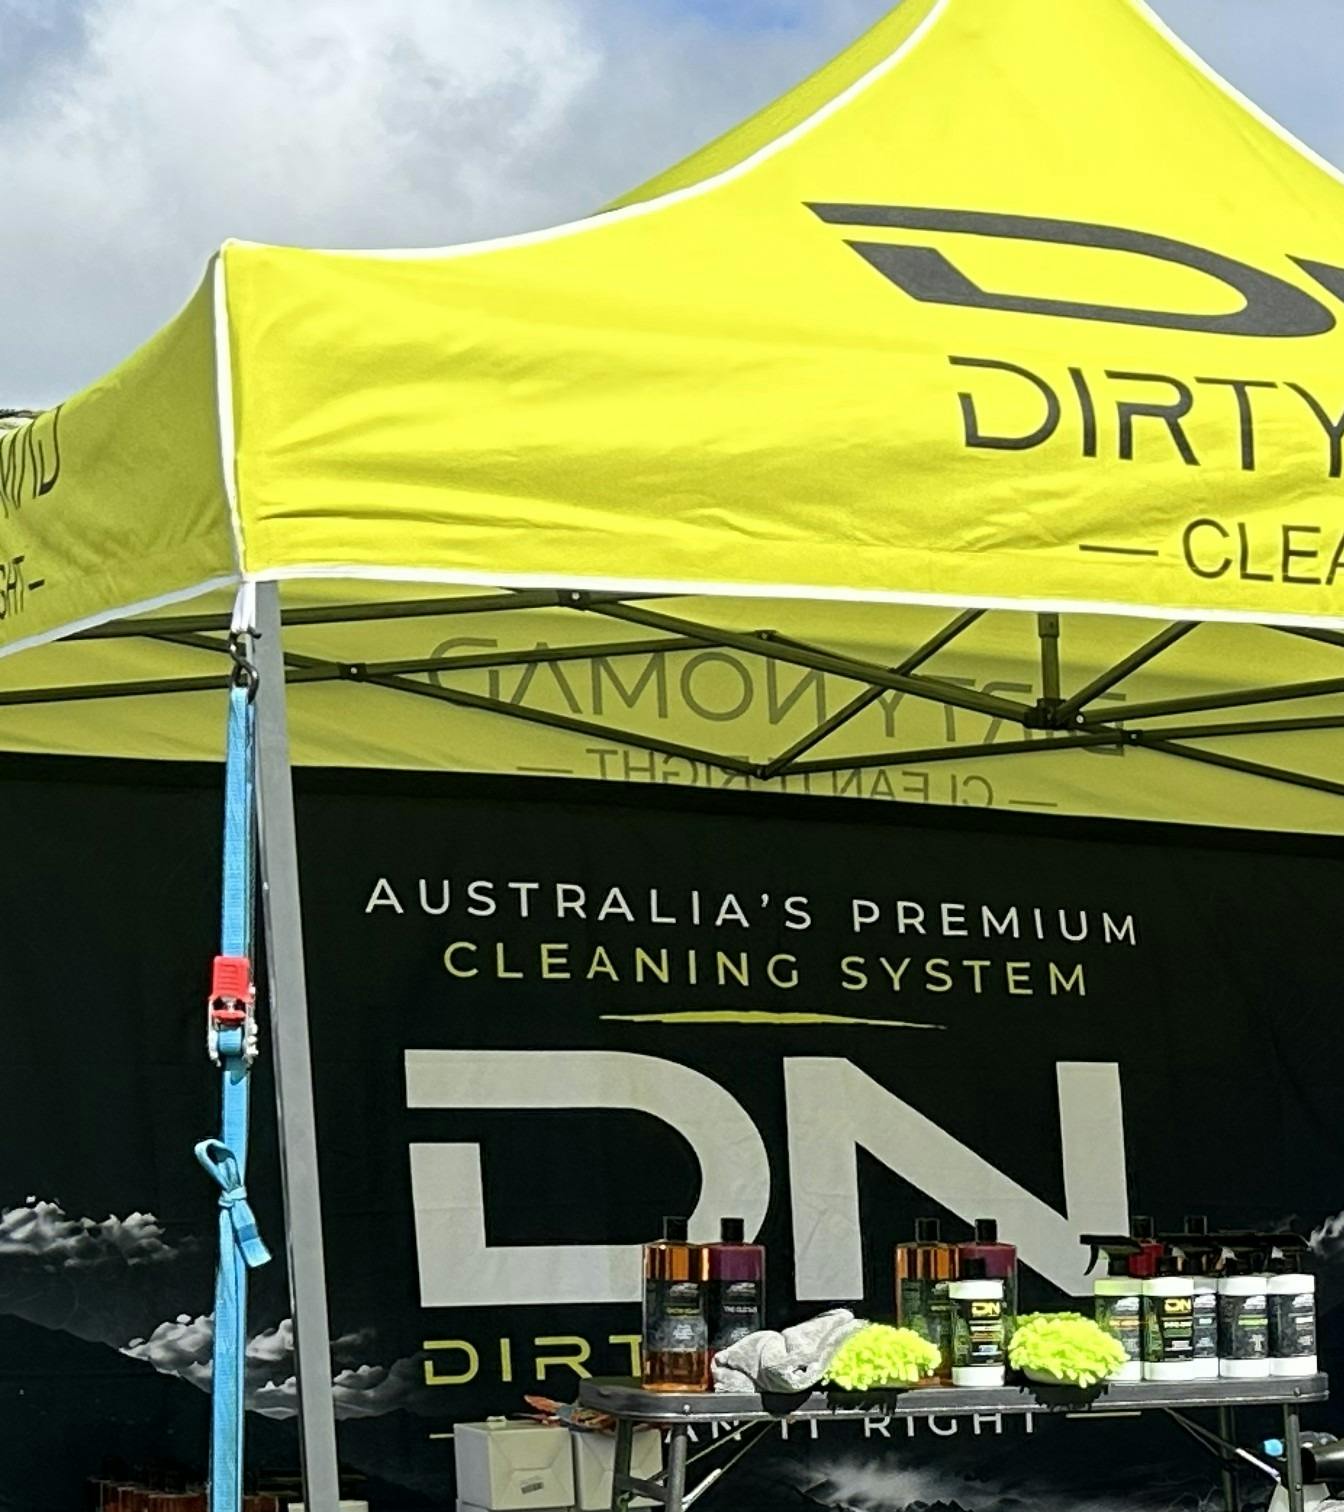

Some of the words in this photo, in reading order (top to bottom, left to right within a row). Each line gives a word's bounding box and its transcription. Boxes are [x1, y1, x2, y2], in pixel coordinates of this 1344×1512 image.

[365, 878, 813, 930] AUSTRALIA'S
[853, 899, 1137, 946] PREMIUM
[444, 941, 800, 989] CLEANING
[841, 956, 1087, 996] SYSTEM
[404, 1048, 1131, 1308] DN
[423, 1335, 643, 1385] DIRT
